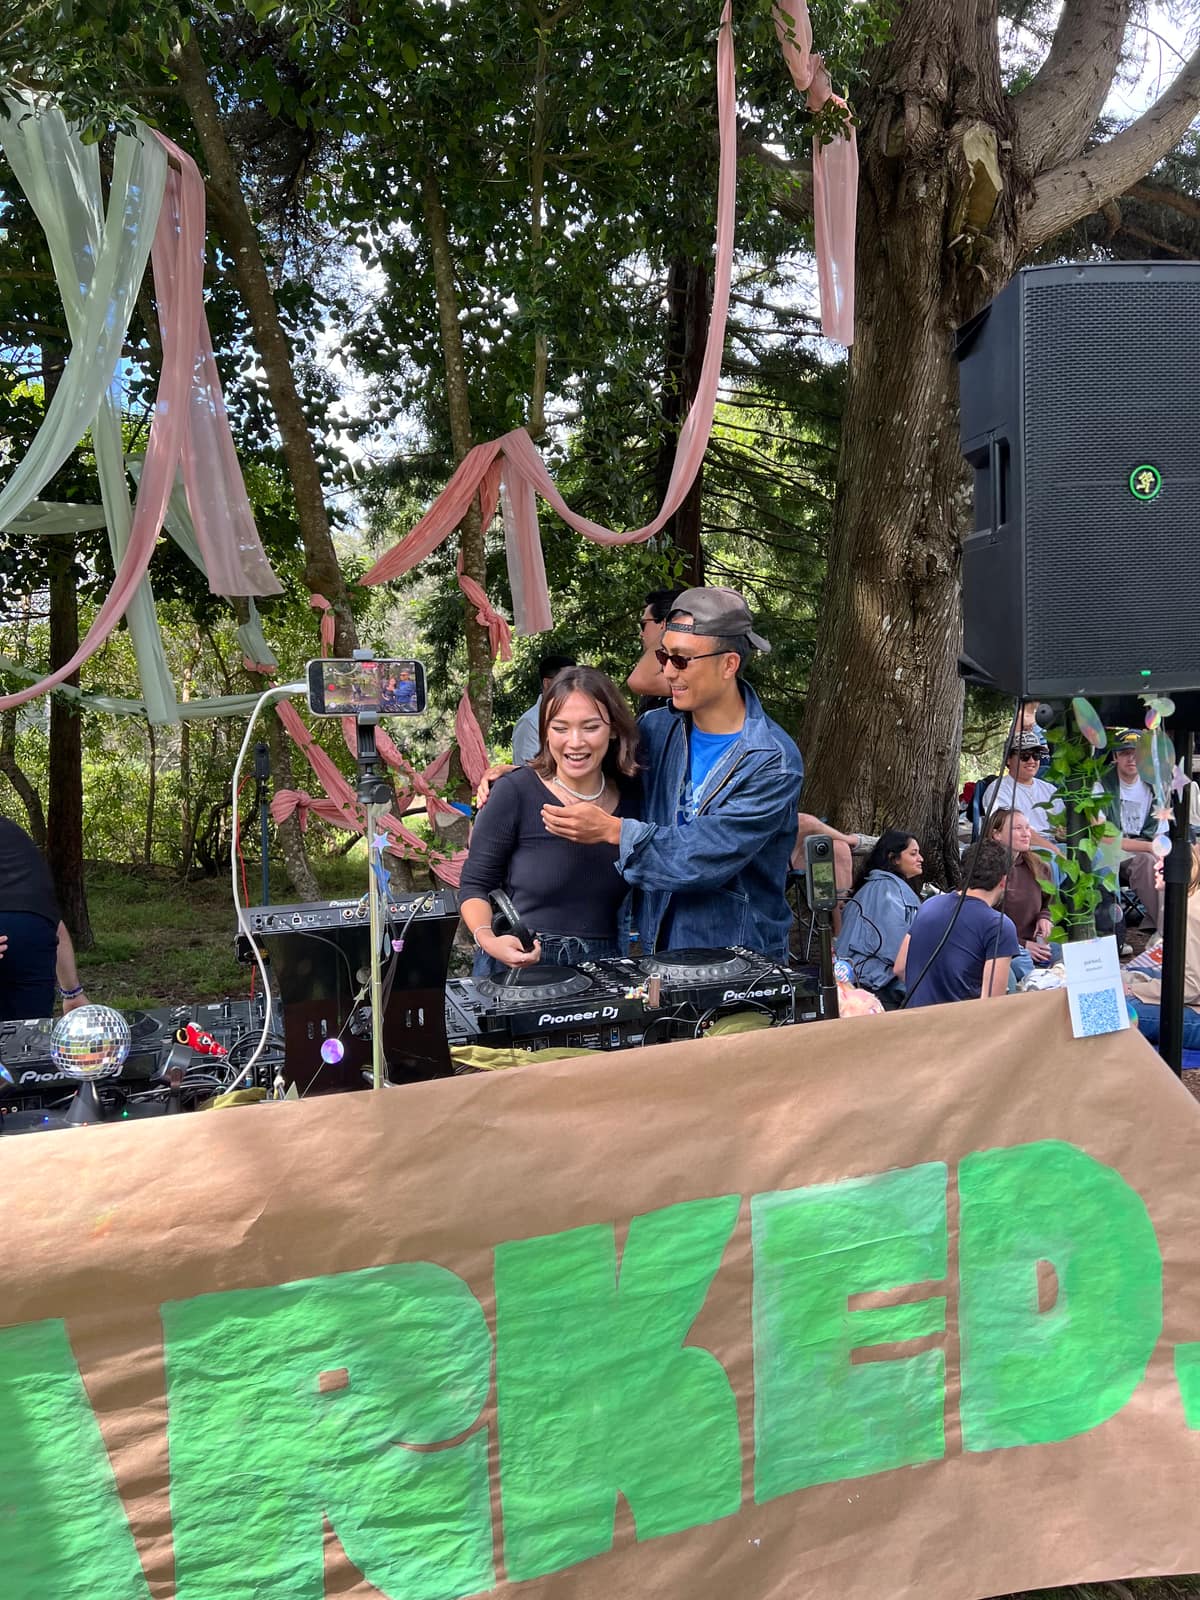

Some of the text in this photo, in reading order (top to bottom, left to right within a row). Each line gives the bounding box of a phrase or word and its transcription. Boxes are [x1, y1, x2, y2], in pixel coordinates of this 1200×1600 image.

[723, 987, 779, 1001] Pioneer
[538, 1010, 600, 1026] Pioneer
[19, 1070, 66, 1084] Pion
